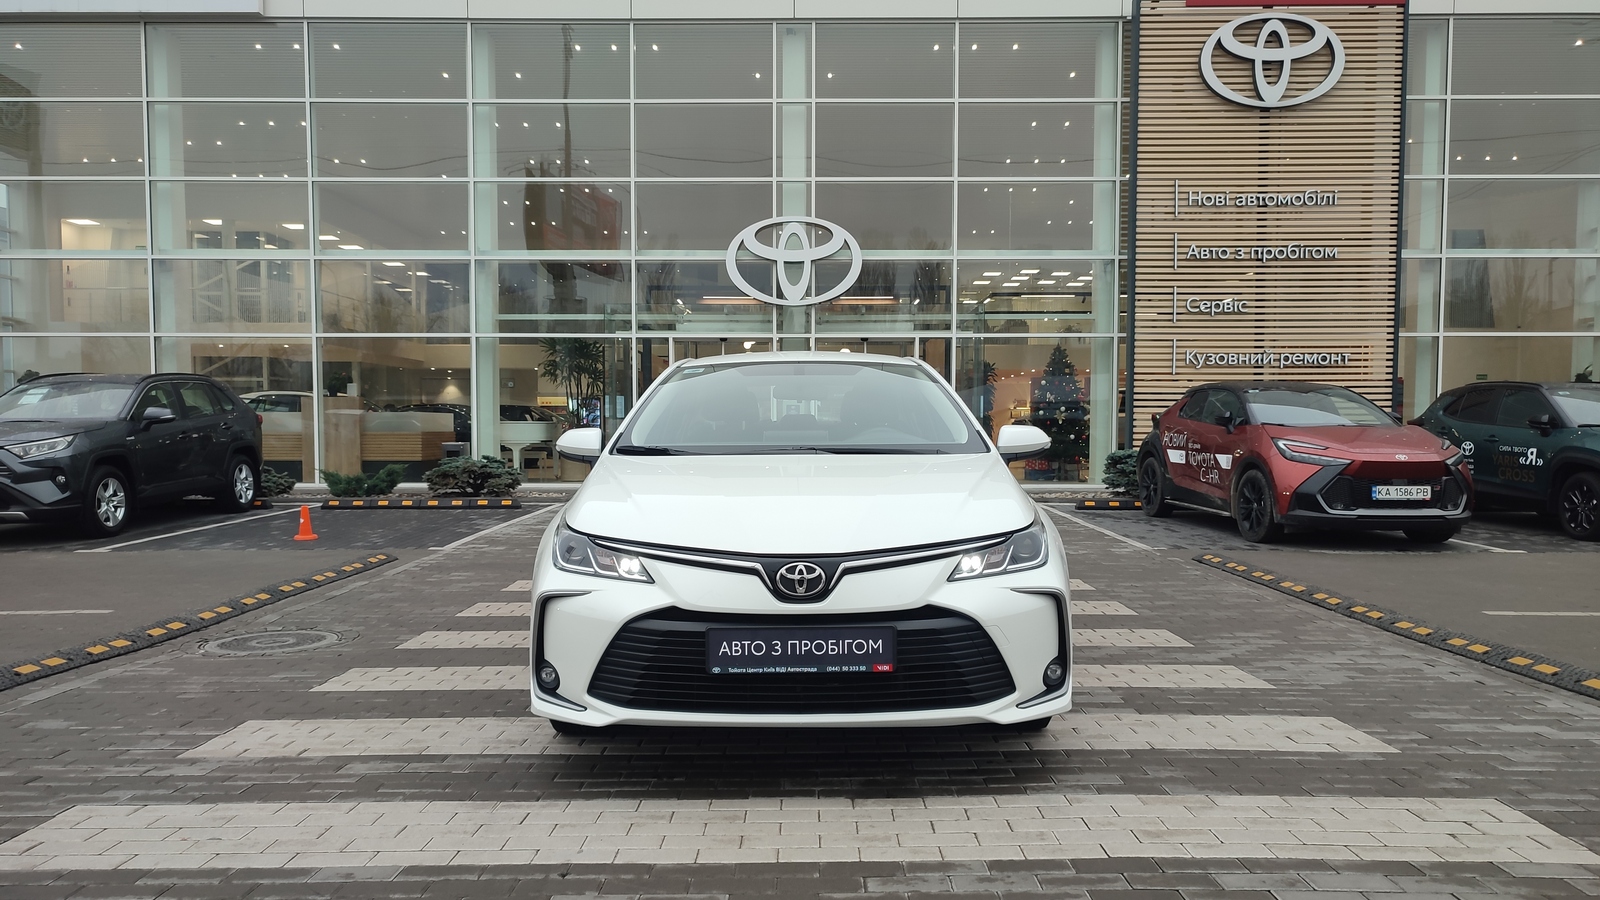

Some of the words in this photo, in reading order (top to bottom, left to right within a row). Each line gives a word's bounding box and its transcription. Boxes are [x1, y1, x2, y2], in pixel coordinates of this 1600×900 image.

[1188, 190, 1230, 206] Нові
[1235, 189, 1338, 206] автомобілі
[1186, 244, 1230, 259] Авто
[1234, 248, 1244, 259] з
[1250, 243, 1338, 262] пробігом
[1185, 297, 1249, 316] Сервіс
[1185, 349, 1274, 368] Кузовний
[1280, 351, 1350, 368] ремонт
[1188, 451, 1216, 467] TOYOTA
[1200, 468, 1220, 483] C-HR
[1498, 467, 1535, 483] CROSS
[1394, 488, 1414, 497] 1586
[719, 640, 766, 656] АВТО
[788, 639, 883, 655] ПРОБІГОМ
